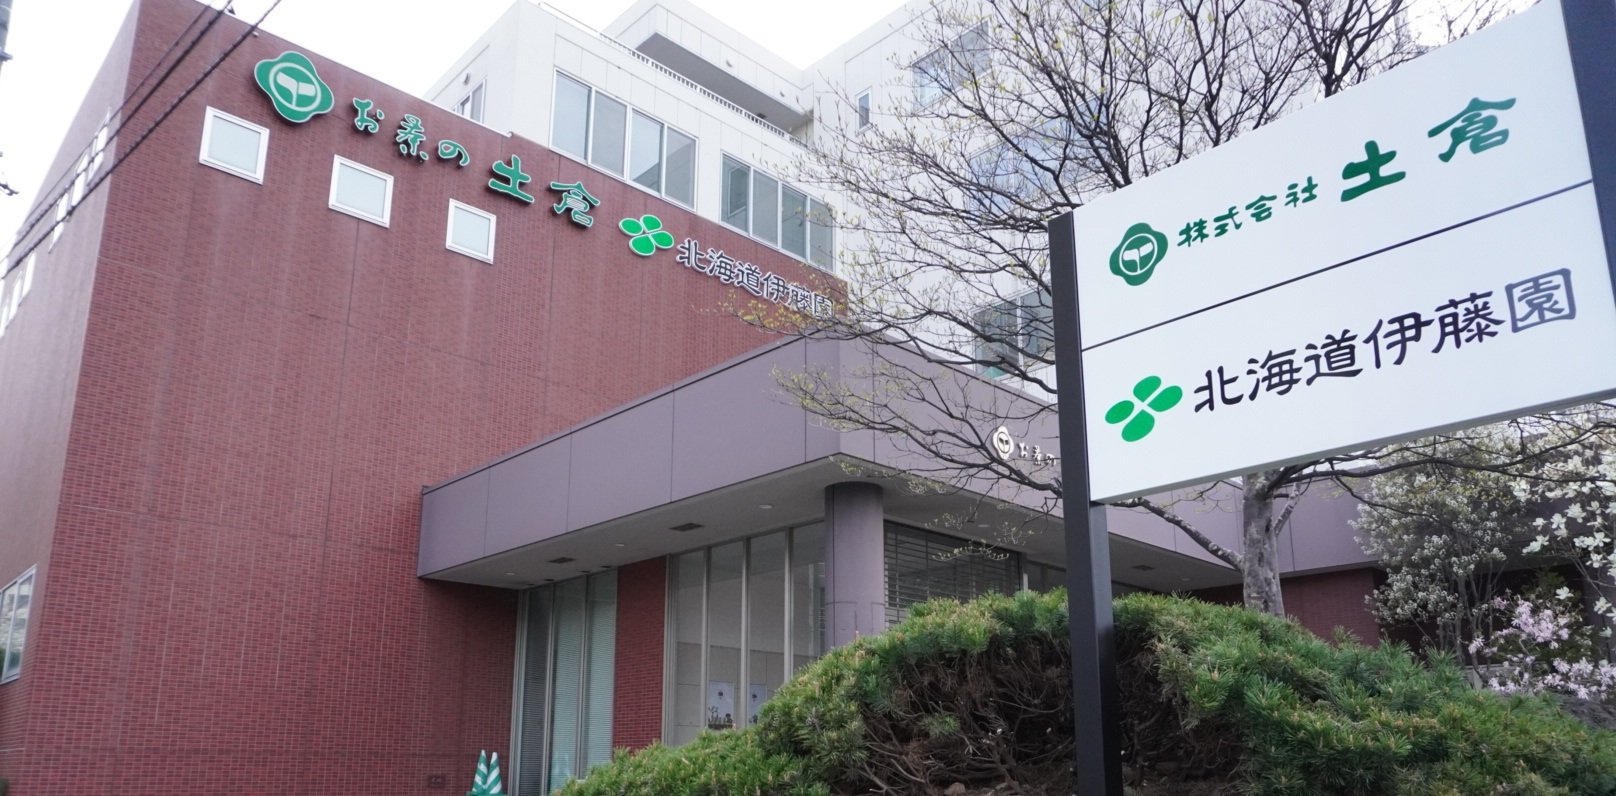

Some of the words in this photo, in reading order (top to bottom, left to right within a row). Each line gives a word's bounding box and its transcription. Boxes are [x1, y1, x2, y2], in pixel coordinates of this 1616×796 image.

[1193, 268, 1577, 414] 北海道伊藤園
